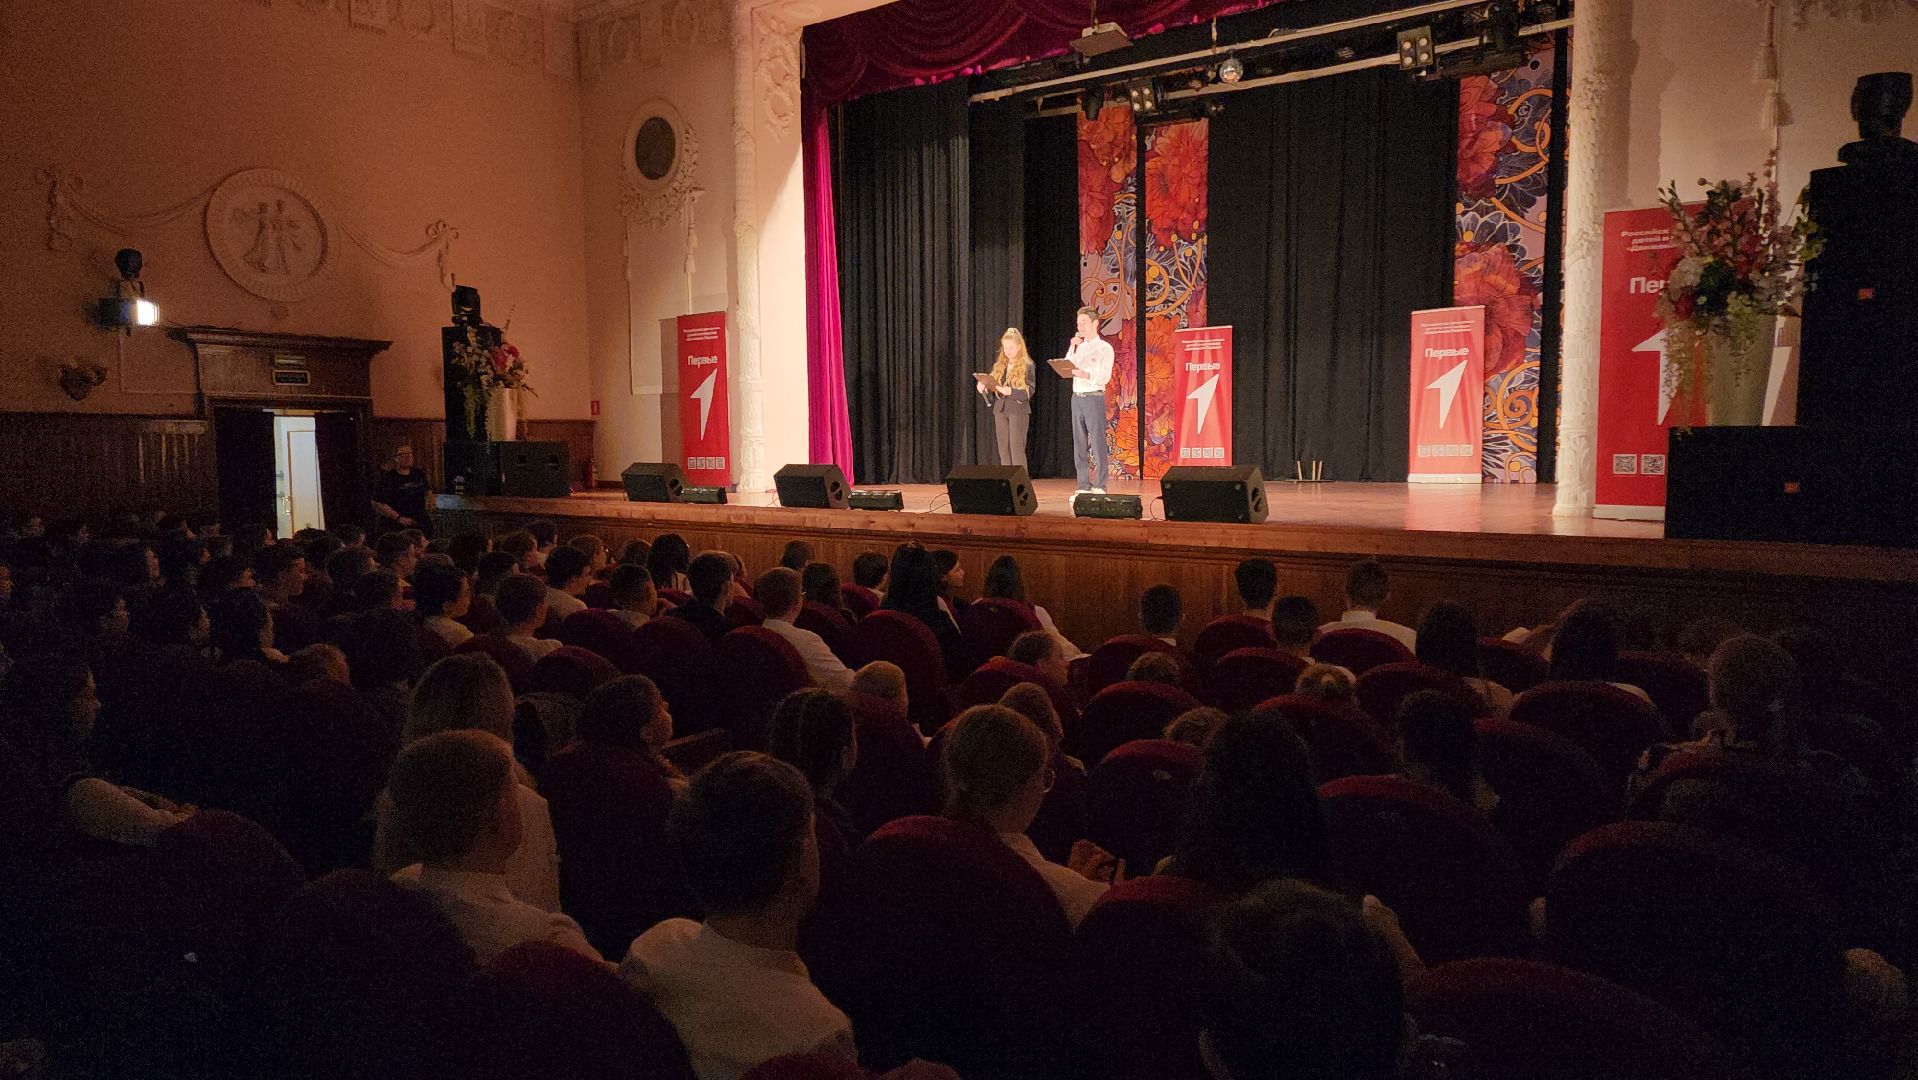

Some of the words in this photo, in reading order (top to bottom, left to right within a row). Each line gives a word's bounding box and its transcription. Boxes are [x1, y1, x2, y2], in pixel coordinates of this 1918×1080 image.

[1425, 347, 1469, 360] Первые
[687, 355, 718, 368] Первые
[1185, 362, 1221, 374] Первые
